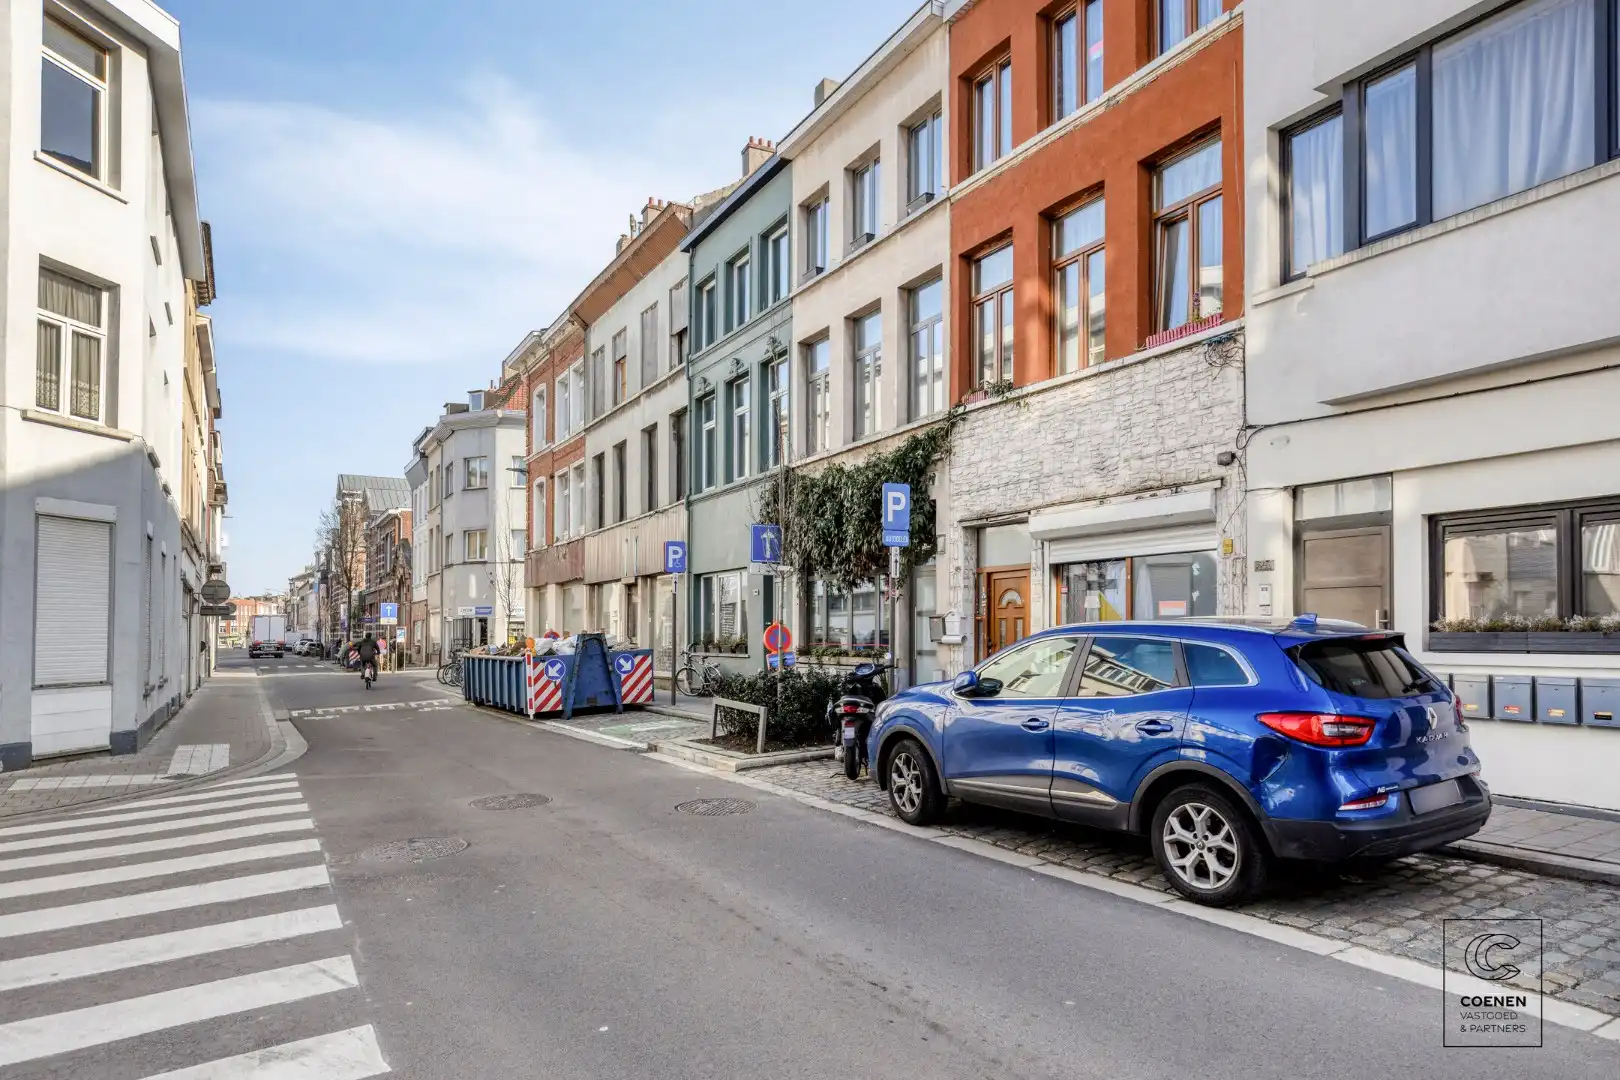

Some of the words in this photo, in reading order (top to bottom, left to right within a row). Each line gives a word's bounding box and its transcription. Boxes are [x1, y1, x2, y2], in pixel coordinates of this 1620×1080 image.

[887, 491, 907, 522] P
[668, 545, 683, 568] P
[1416, 732, 1448, 743] KADJAR
